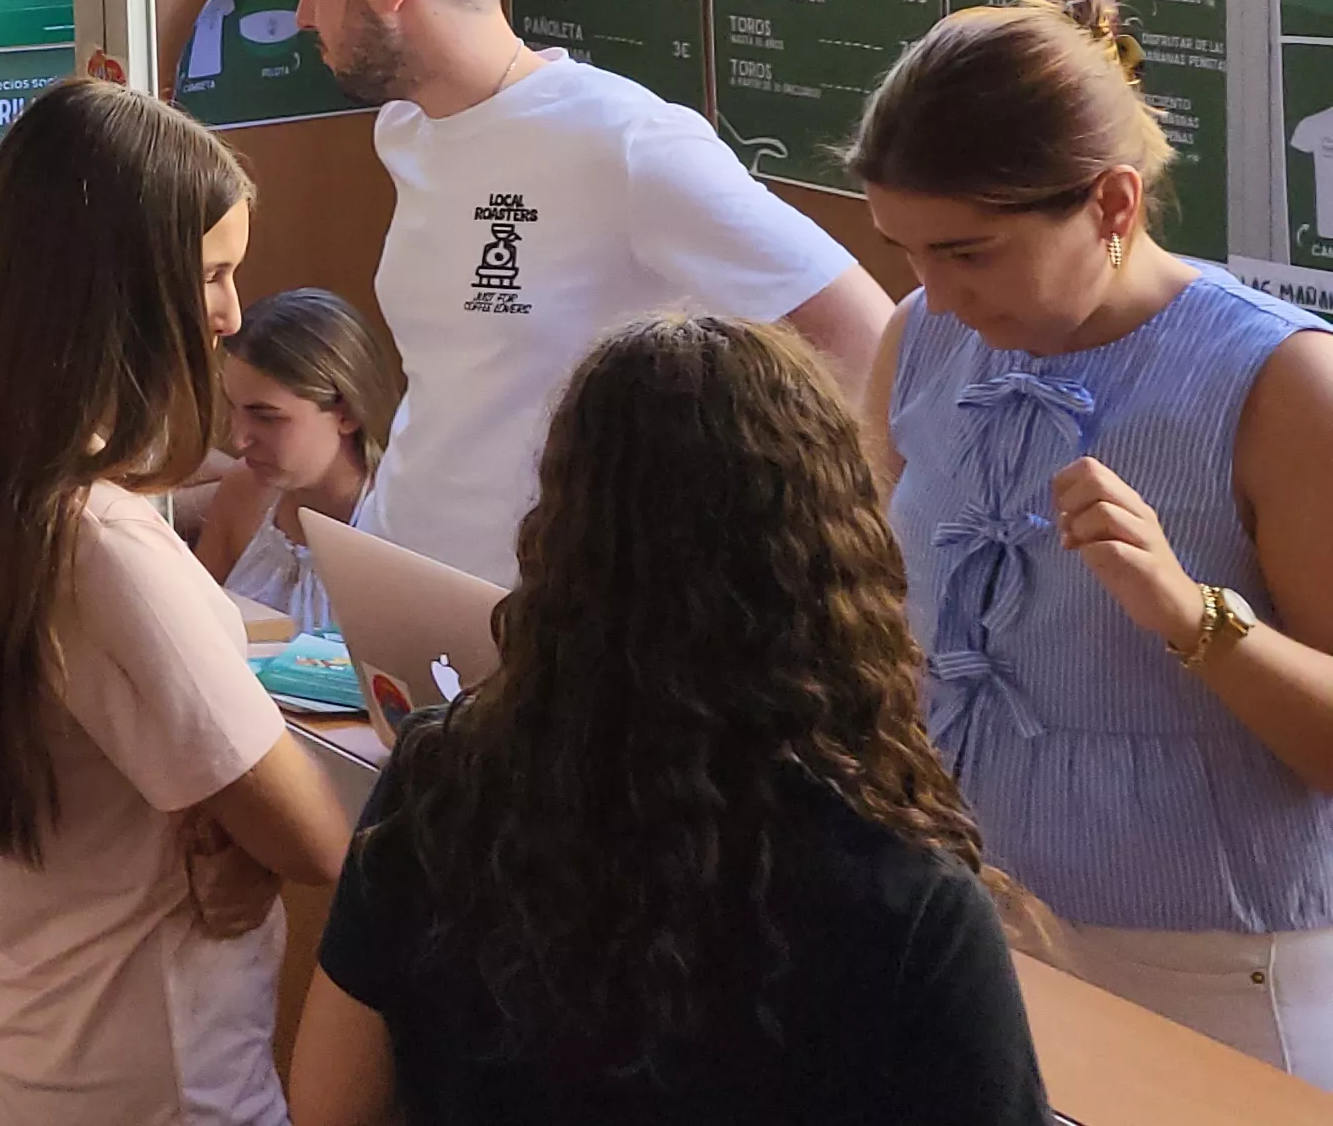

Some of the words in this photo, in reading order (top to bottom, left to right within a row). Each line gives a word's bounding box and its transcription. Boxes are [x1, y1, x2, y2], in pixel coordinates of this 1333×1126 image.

[728, 15, 771, 36] TOROS
[730, 59, 772, 80] TOROS
[489, 193, 525, 207] LOCAL
[473, 207, 539, 222] ROASTERS
